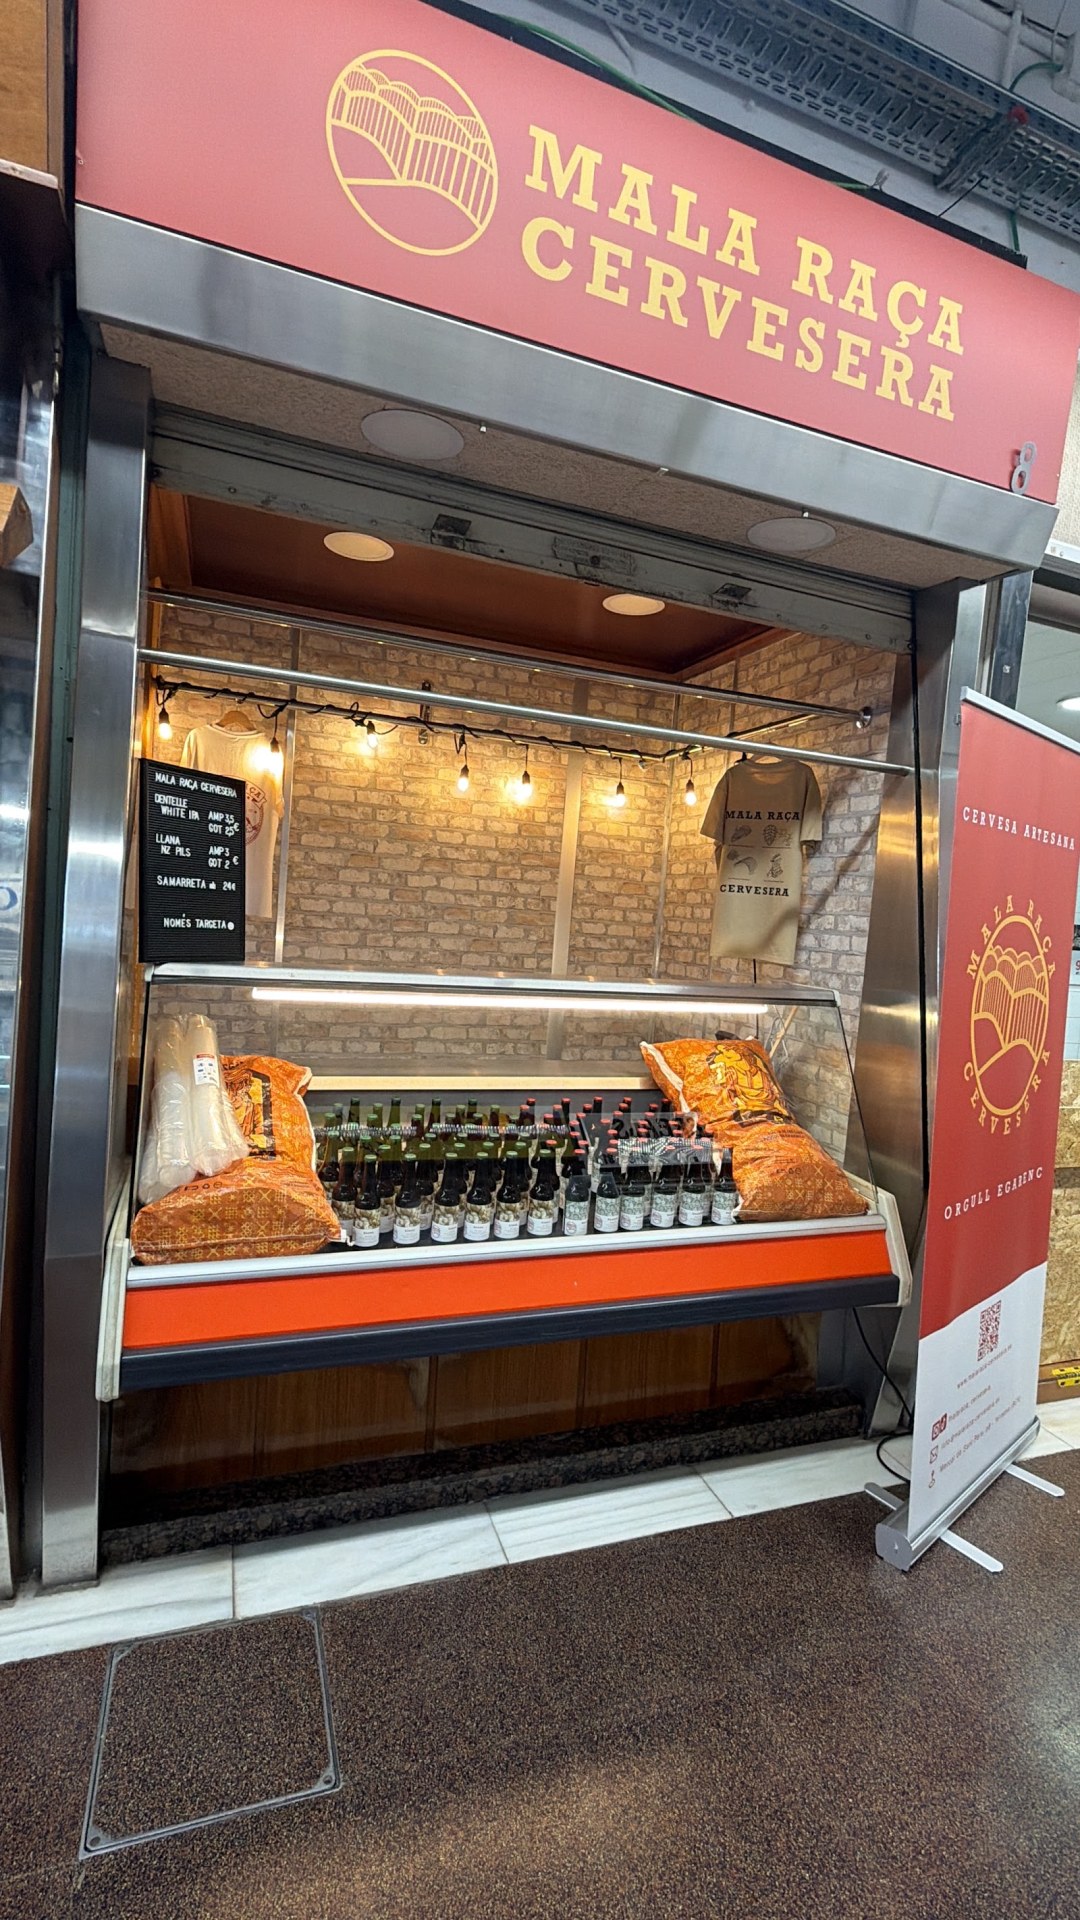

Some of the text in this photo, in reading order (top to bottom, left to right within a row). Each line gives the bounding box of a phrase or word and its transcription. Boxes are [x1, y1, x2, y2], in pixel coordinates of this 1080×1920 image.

[525, 124, 964, 356] MALA RAÇA
[521, 216, 955, 422] CERVESERA
[1011, 440, 1038, 495] 8
[155, 772, 238, 799] MALA RAÇA CERVESERA
[154, 793, 189, 809] DENTELLE
[161, 805, 200, 821] WHITE IPA
[208, 811, 224, 822] AMP
[725, 810, 800, 822] MALA RAÇA
[208, 823, 223, 835] GOT
[962, 806, 1076, 851] CERVESA ARTESANA
[155, 833, 181, 846] LLANA
[161, 844, 191, 857] NZ PILS
[208, 846, 230, 857] AMP 3
[208, 857, 222, 868] GOT
[224, 860, 230, 870] 2
[157, 875, 207, 890] SAMARRETA
[719, 884, 790, 897] CERVESERA
[195, 918, 227, 930] TARGETA
[966, 895, 1014, 980] MALA
[963, 1049, 1050, 1135] CERVESERA
[944, 1166, 1043, 1220] ORGULL EGARENC
